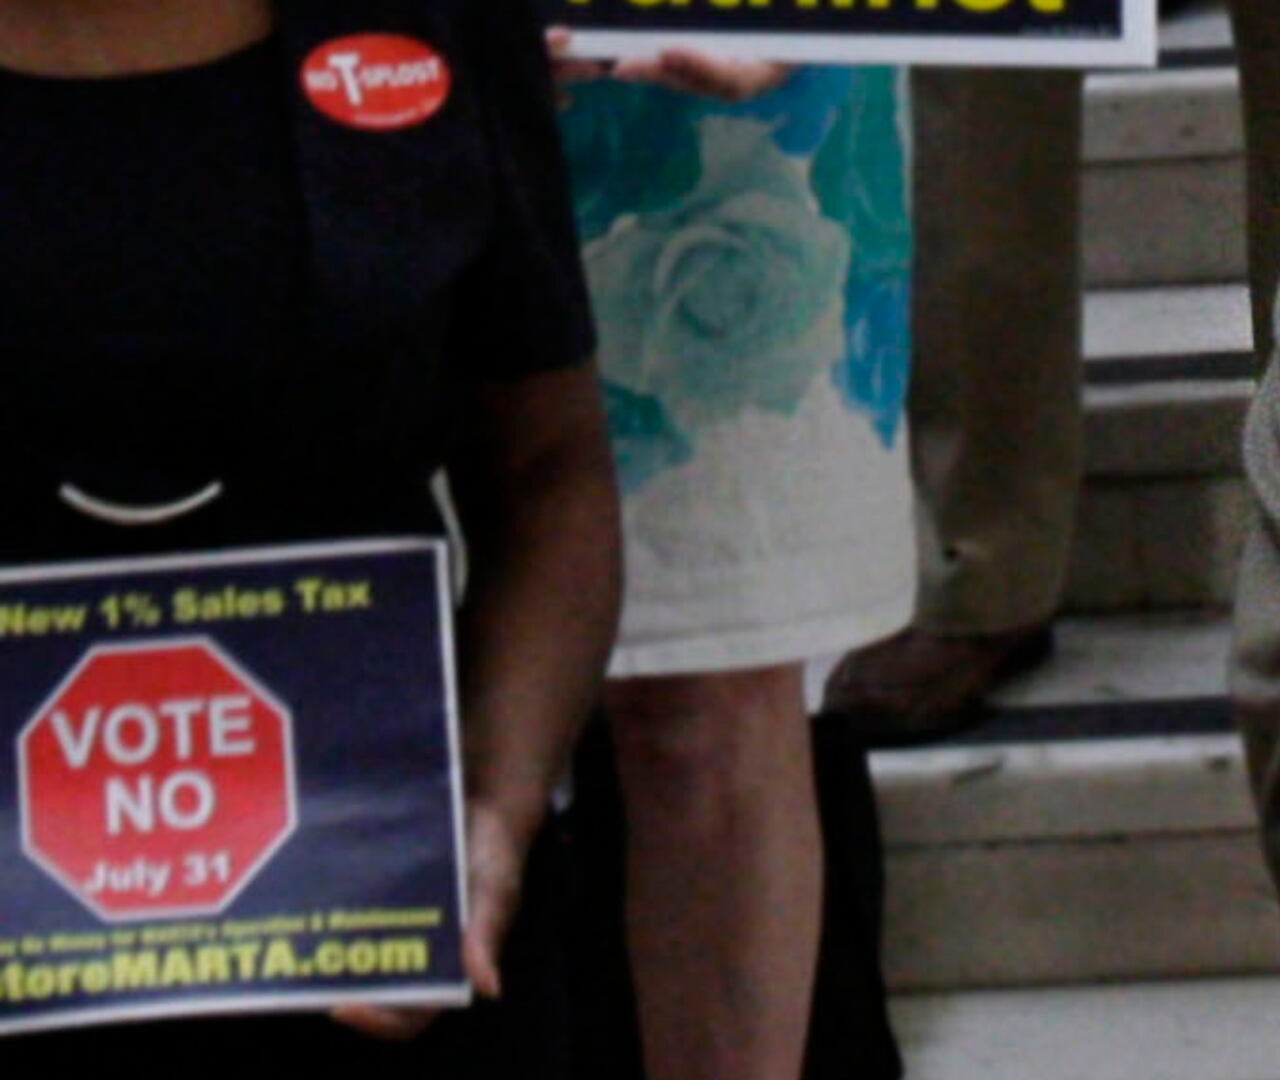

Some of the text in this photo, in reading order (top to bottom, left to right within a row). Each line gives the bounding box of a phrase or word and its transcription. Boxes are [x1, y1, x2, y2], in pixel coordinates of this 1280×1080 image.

[99, 592, 161, 630] 1%
[173, 583, 284, 622] Sales
[296, 577, 372, 612] Tax
[51, 694, 257, 769] VOTE
[105, 770, 216, 835] NO
[84, 851, 232, 896] July 31
[0, 937, 429, 1003] toreMARTA.com
